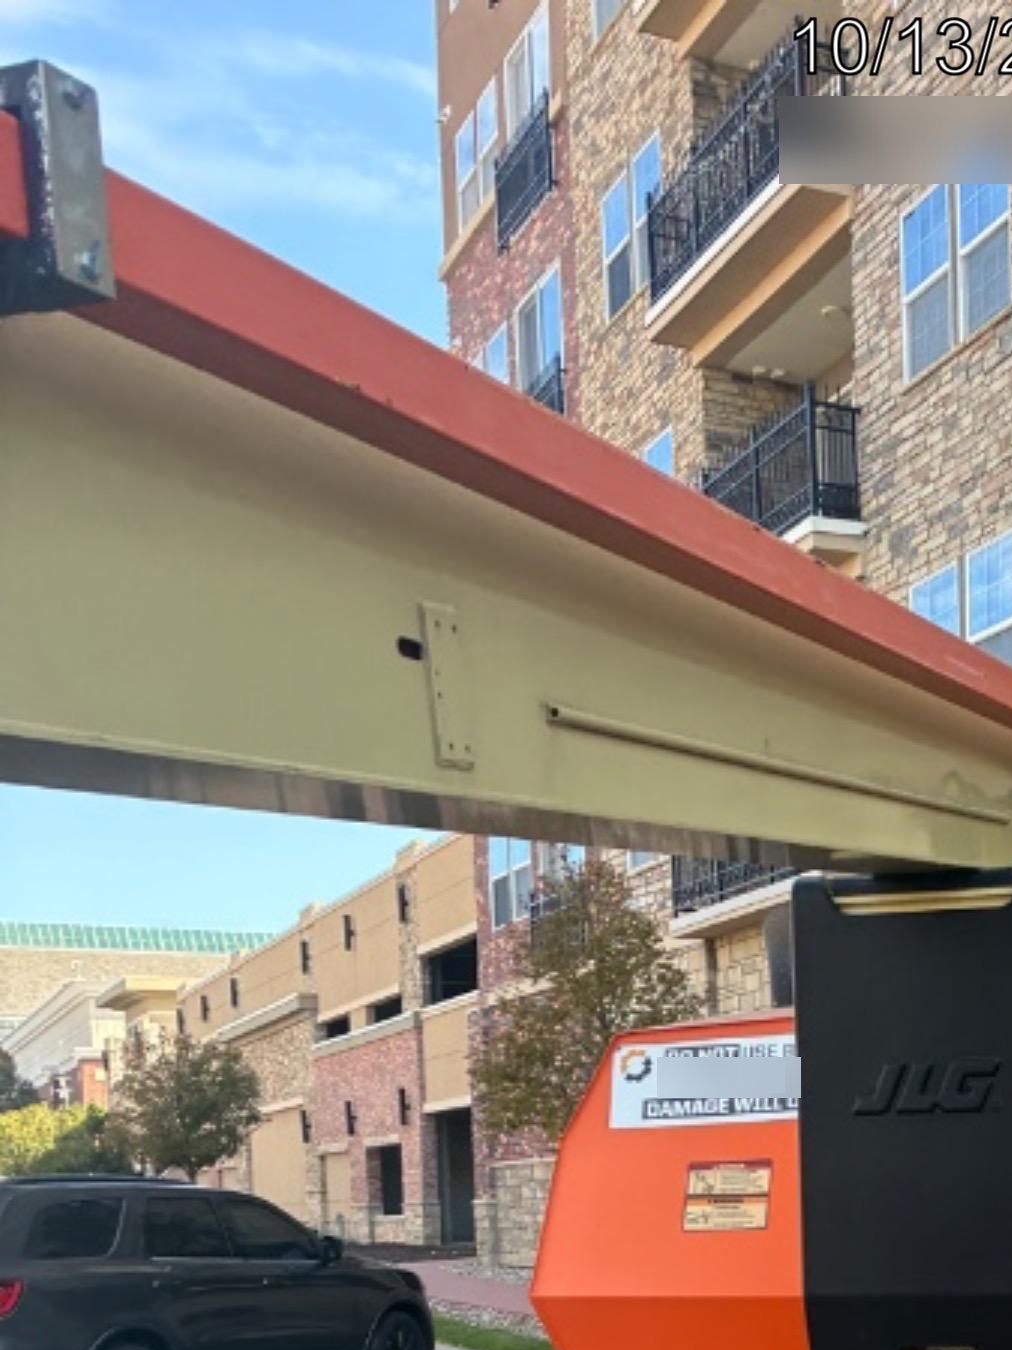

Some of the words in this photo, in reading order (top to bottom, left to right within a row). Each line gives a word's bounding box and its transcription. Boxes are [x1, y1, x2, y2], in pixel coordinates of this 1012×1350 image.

[852, 1058, 1002, 1116] JLG
[646, 1099, 730, 1117] DAMAGE
[734, 1097, 783, 1112] WILL
